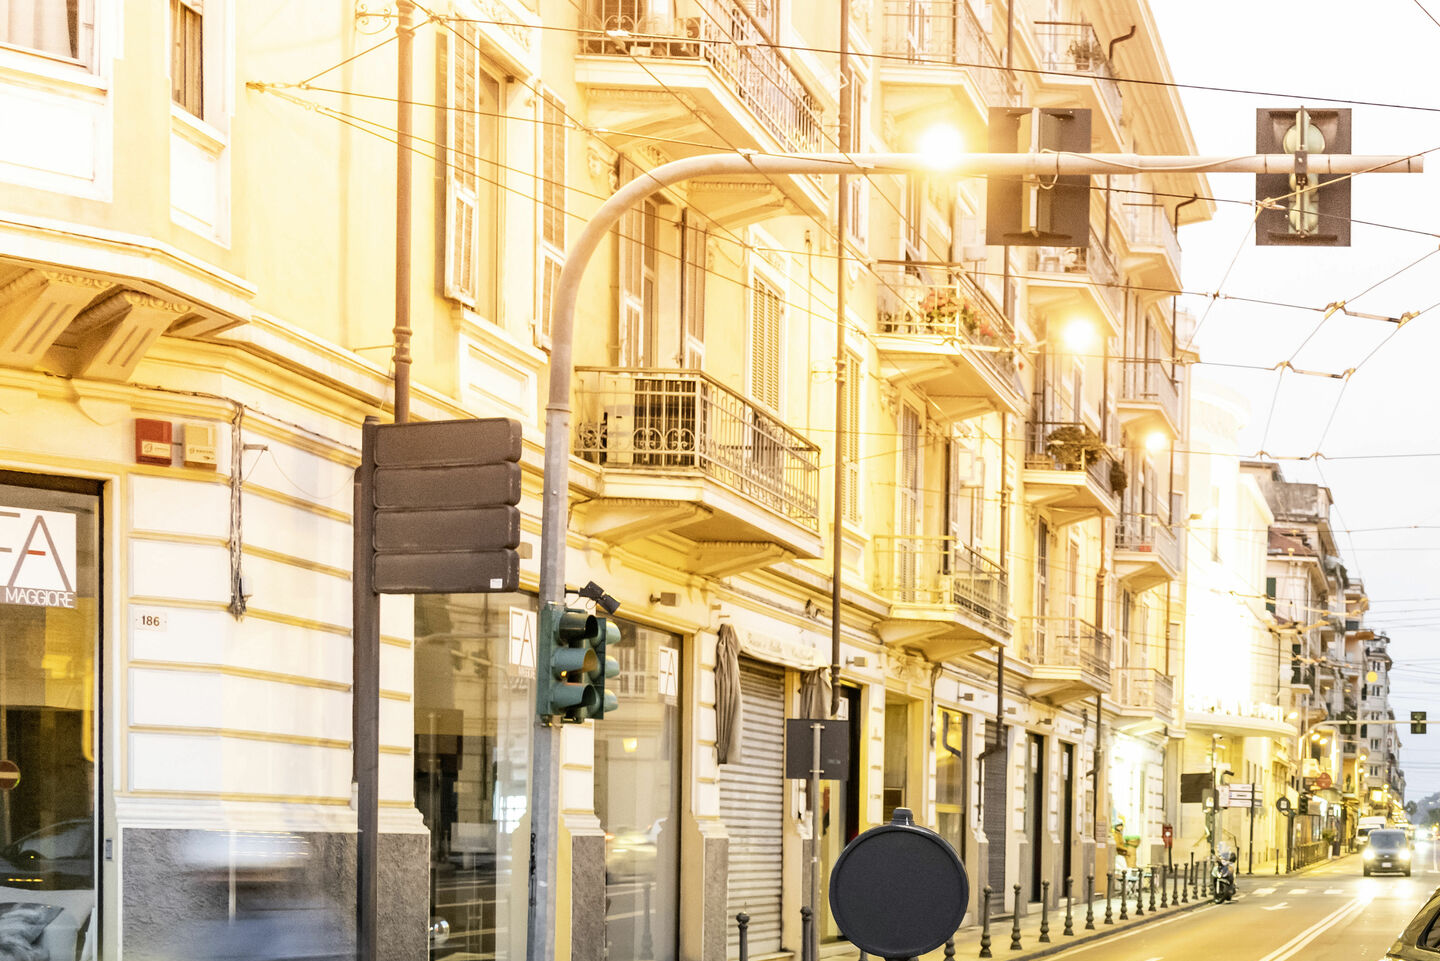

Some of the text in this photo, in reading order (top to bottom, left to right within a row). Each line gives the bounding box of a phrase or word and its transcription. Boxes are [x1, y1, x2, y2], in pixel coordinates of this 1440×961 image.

[5, 587, 74, 609] MAGGIORE
[142, 615, 160, 627] 186
[510, 610, 536, 668] FA
